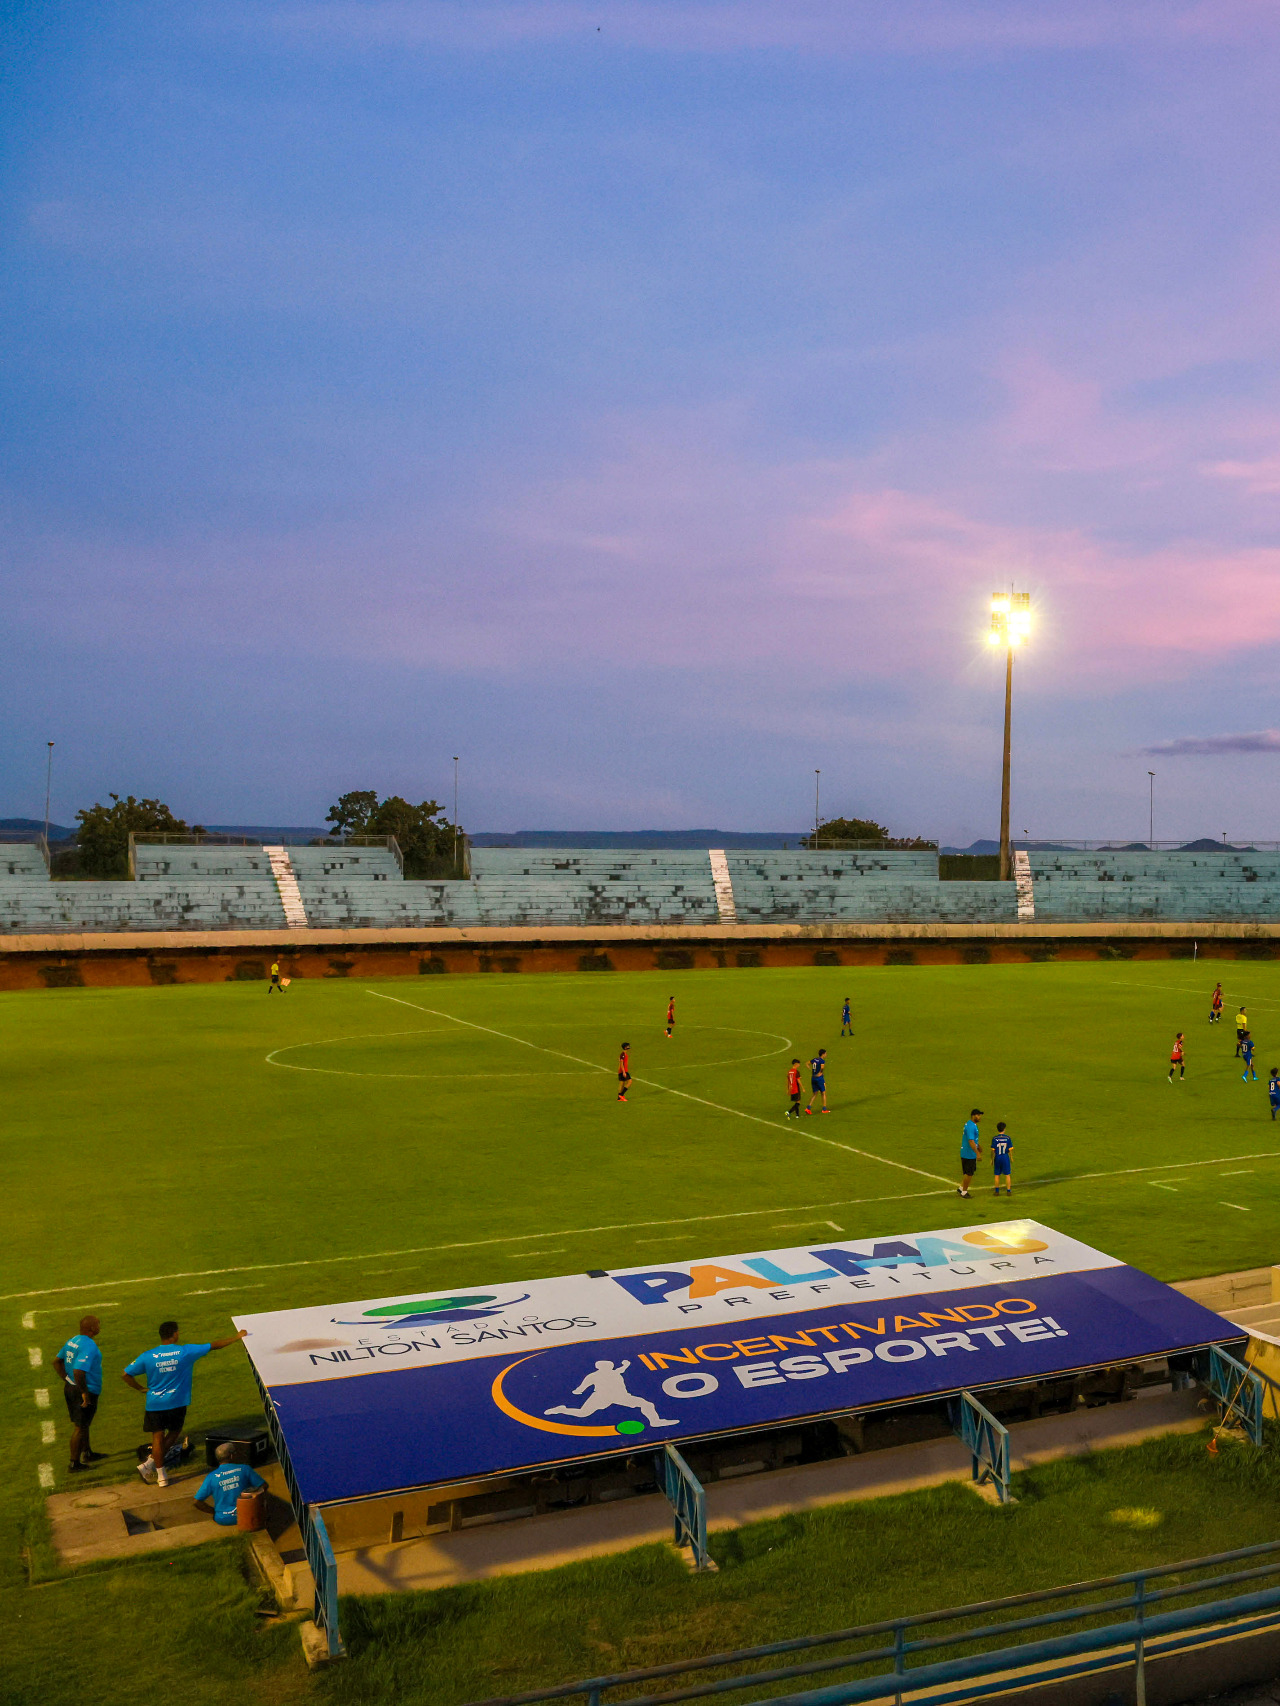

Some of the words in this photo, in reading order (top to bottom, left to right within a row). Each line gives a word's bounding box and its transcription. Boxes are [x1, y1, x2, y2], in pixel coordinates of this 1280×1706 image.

[996, 1142, 1007, 1155] 17
[611, 1229, 1049, 1306] PALMAS
[677, 1256, 1055, 1314] PREFEITURA
[308, 1337, 441, 1366] NILTON
[450, 1315, 598, 1346] SANTOS
[637, 1298, 1038, 1371] INCENTIVANDO
[661, 1372, 720, 1399] O
[731, 1316, 1070, 1389] ESPORTE!
